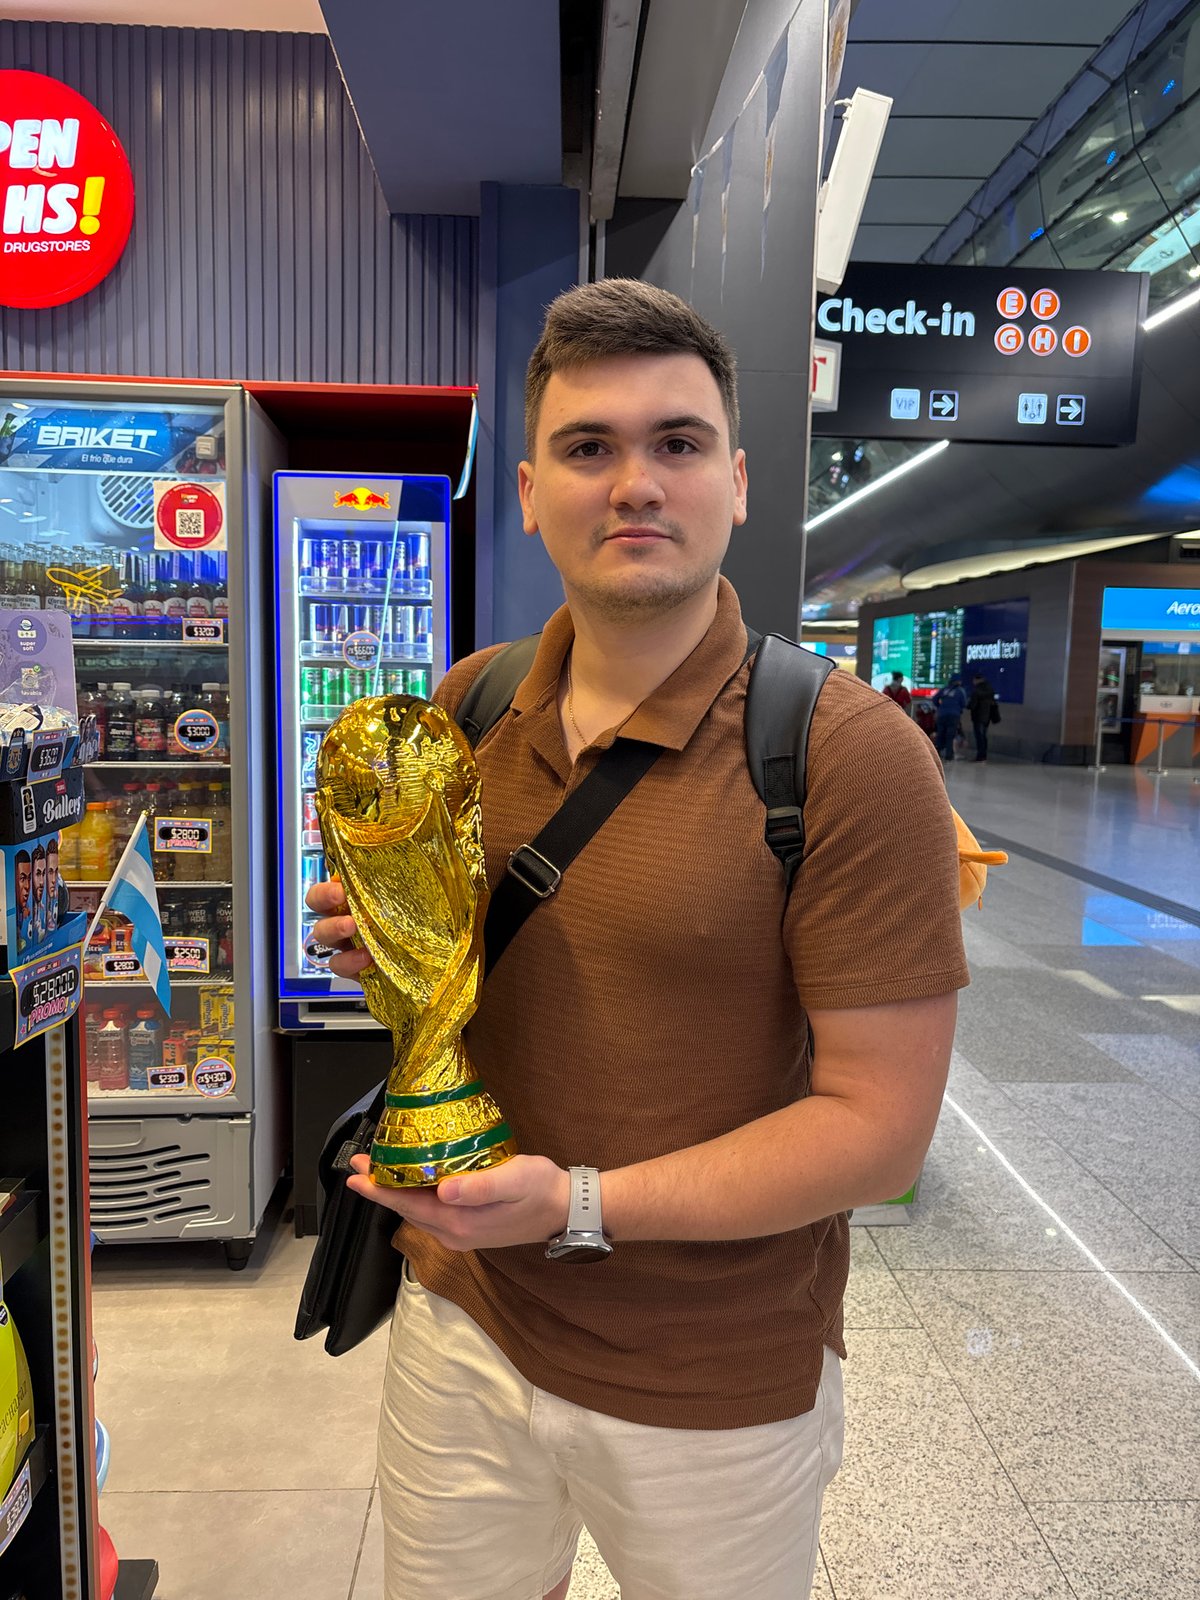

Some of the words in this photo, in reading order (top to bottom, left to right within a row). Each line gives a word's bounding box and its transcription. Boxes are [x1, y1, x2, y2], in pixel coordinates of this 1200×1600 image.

[4, 240, 91, 253] DRUGSTORES
[818, 298, 975, 337] Check-in
[896, 397, 915, 410] VIP
[37, 425, 157, 449] BRIKET
[117, 455, 133, 464] dura
[967, 638, 1000, 662] personal
[1001, 638, 1020, 660] tech
[186, 726, 210, 737] $3000
[171, 828, 199, 840] $2800
[174, 947, 200, 959] $2500
[33, 969, 75, 1008] $28000
[28, 996, 70, 1032] ¡PROMO!
